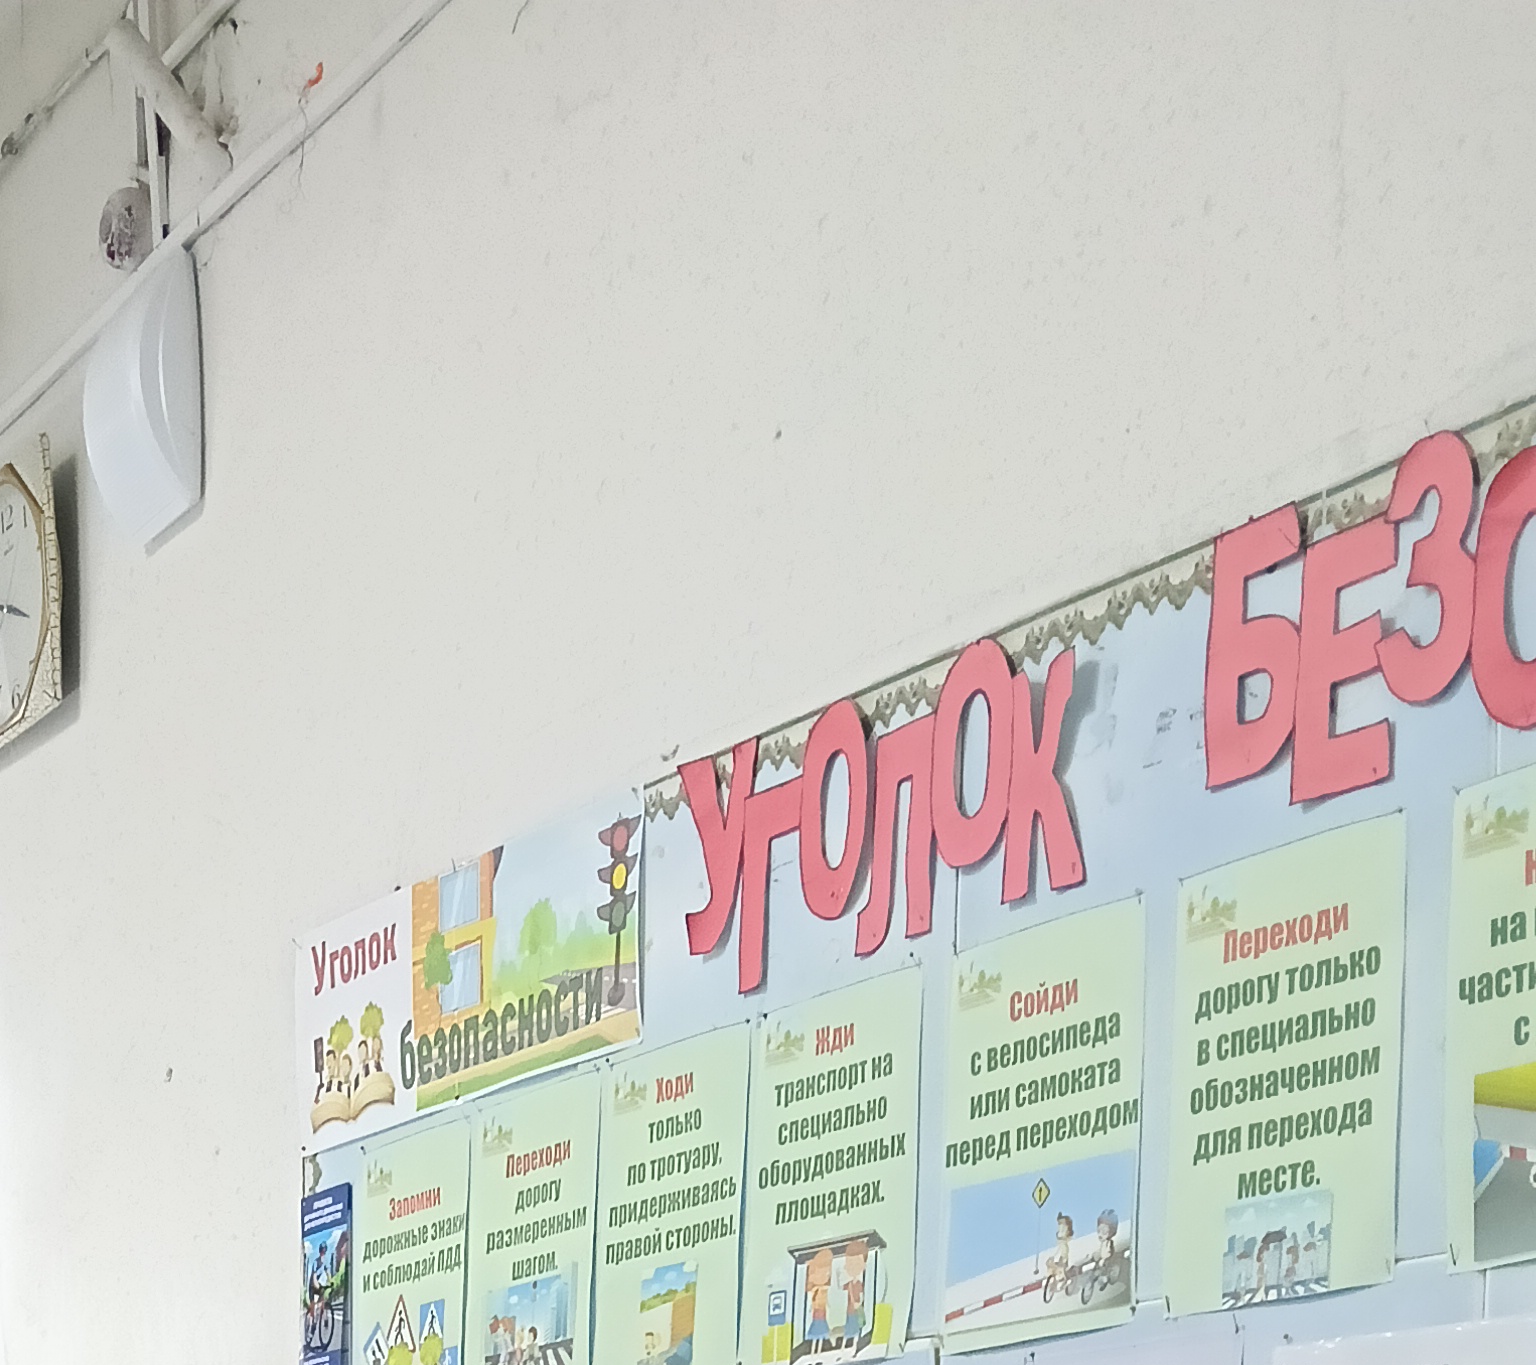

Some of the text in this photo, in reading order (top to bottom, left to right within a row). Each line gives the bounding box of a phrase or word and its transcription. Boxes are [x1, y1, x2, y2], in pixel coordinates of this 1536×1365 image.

[0, 504, 29, 536] 12 1
[11, 683, 22, 710] 6
[677, 638, 1087, 994] УГОЛОК
[1223, 902, 1349, 965] Переходи
[1491, 911, 1527, 948] на
[311, 923, 397, 996] Уголок
[1009, 978, 1079, 1022] Сойди
[1195, 945, 1381, 1025] дорогу только
[400, 968, 604, 1090] безопасности
[815, 1018, 855, 1056] Жди
[971, 1011, 1121, 1077] с велосипеда
[1197, 997, 1376, 1067] в специально
[1514, 1015, 1530, 1046] с
[656, 1072, 694, 1104] Ходи
[774, 1052, 894, 1109] транспорт на
[970, 1057, 1121, 1121] или самоката
[1190, 1046, 1381, 1116] обозначенном
[648, 1108, 703, 1144] только
[778, 1095, 888, 1147] специально
[945, 1098, 1139, 1169] перед переходом
[1193, 1098, 1373, 1167] для перехода
[506, 1139, 572, 1179] Переходи
[627, 1141, 723, 1187] по тротуару,
[759, 1132, 907, 1191] оборудованных
[1237, 1159, 1321, 1201] месте.
[389, 1187, 441, 1221] Запомни
[515, 1178, 562, 1215] дорогу
[608, 1176, 737, 1228] придерживаясь
[775, 1180, 885, 1226] площадках.
[363, 1213, 466, 1264] дорожные знаки
[486, 1206, 588, 1255] размеренным
[605, 1213, 737, 1266] правой стороны.
[363, 1273, 371, 1293] и
[373, 1251, 436, 1291] соблюдай
[512, 1251, 559, 1281] шагом.
